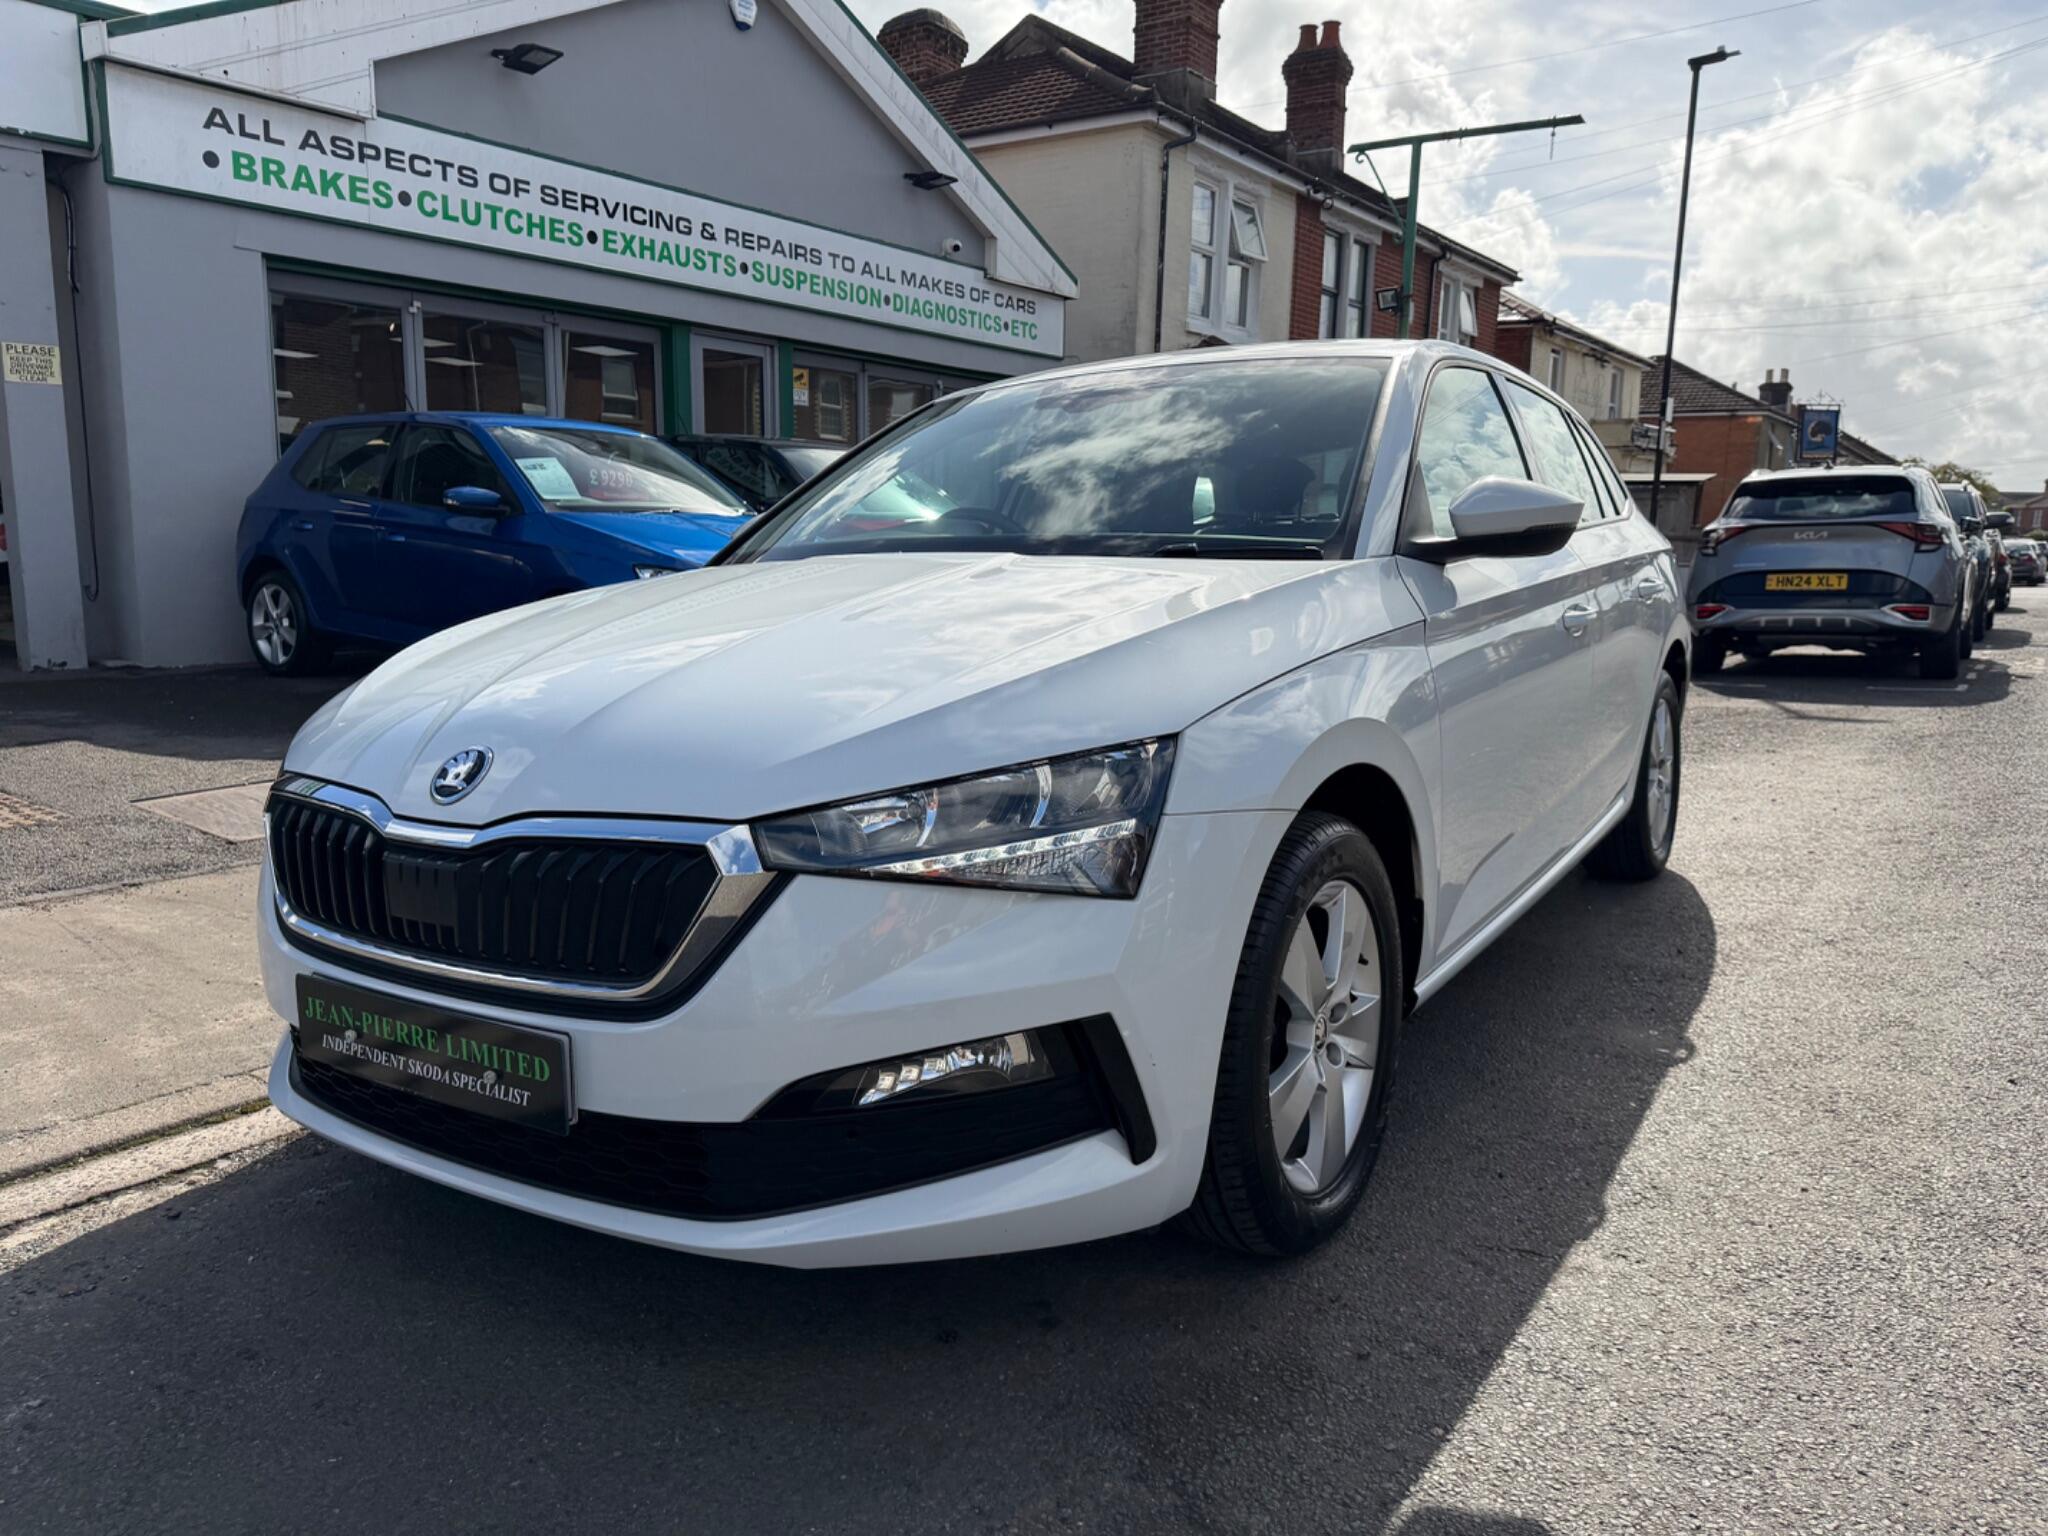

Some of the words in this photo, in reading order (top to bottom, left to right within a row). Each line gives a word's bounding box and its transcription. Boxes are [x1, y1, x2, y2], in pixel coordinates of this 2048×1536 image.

[202, 106, 286, 147] ALL
[298, 129, 478, 189] ASPECTS
[488, 172, 531, 198] OF
[540, 184, 692, 237] SERVICING
[700, 222, 717, 242] &
[725, 227, 823, 267] REPAIRS
[828, 251, 855, 274] TO
[861, 261, 896, 284] ALL
[900, 270, 965, 299] MAKES
[969, 286, 990, 304] OF
[993, 293, 1037, 316] CARS
[231, 150, 394, 210] BRAKES
[416, 190, 584, 248] CLUTCHES
[602, 228, 737, 278] EXHAUSTS
[751, 260, 882, 309] SUSPENSION
[892, 292, 1002, 335] DIAGNOSTICS
[1010, 319, 1039, 341] ETC
[6, 343, 56, 358] PLEASE
[1775, 575, 1812, 588] HN24
[1816, 575, 1845, 588] XLT
[305, 996, 440, 1053] JEAN-PIERRE
[446, 1033, 551, 1082] LIMITED
[322, 1033, 407, 1071] INDEPENDENT
[408, 1058, 450, 1086] SKODA
[451, 1071, 532, 1107] SPECIALIST
